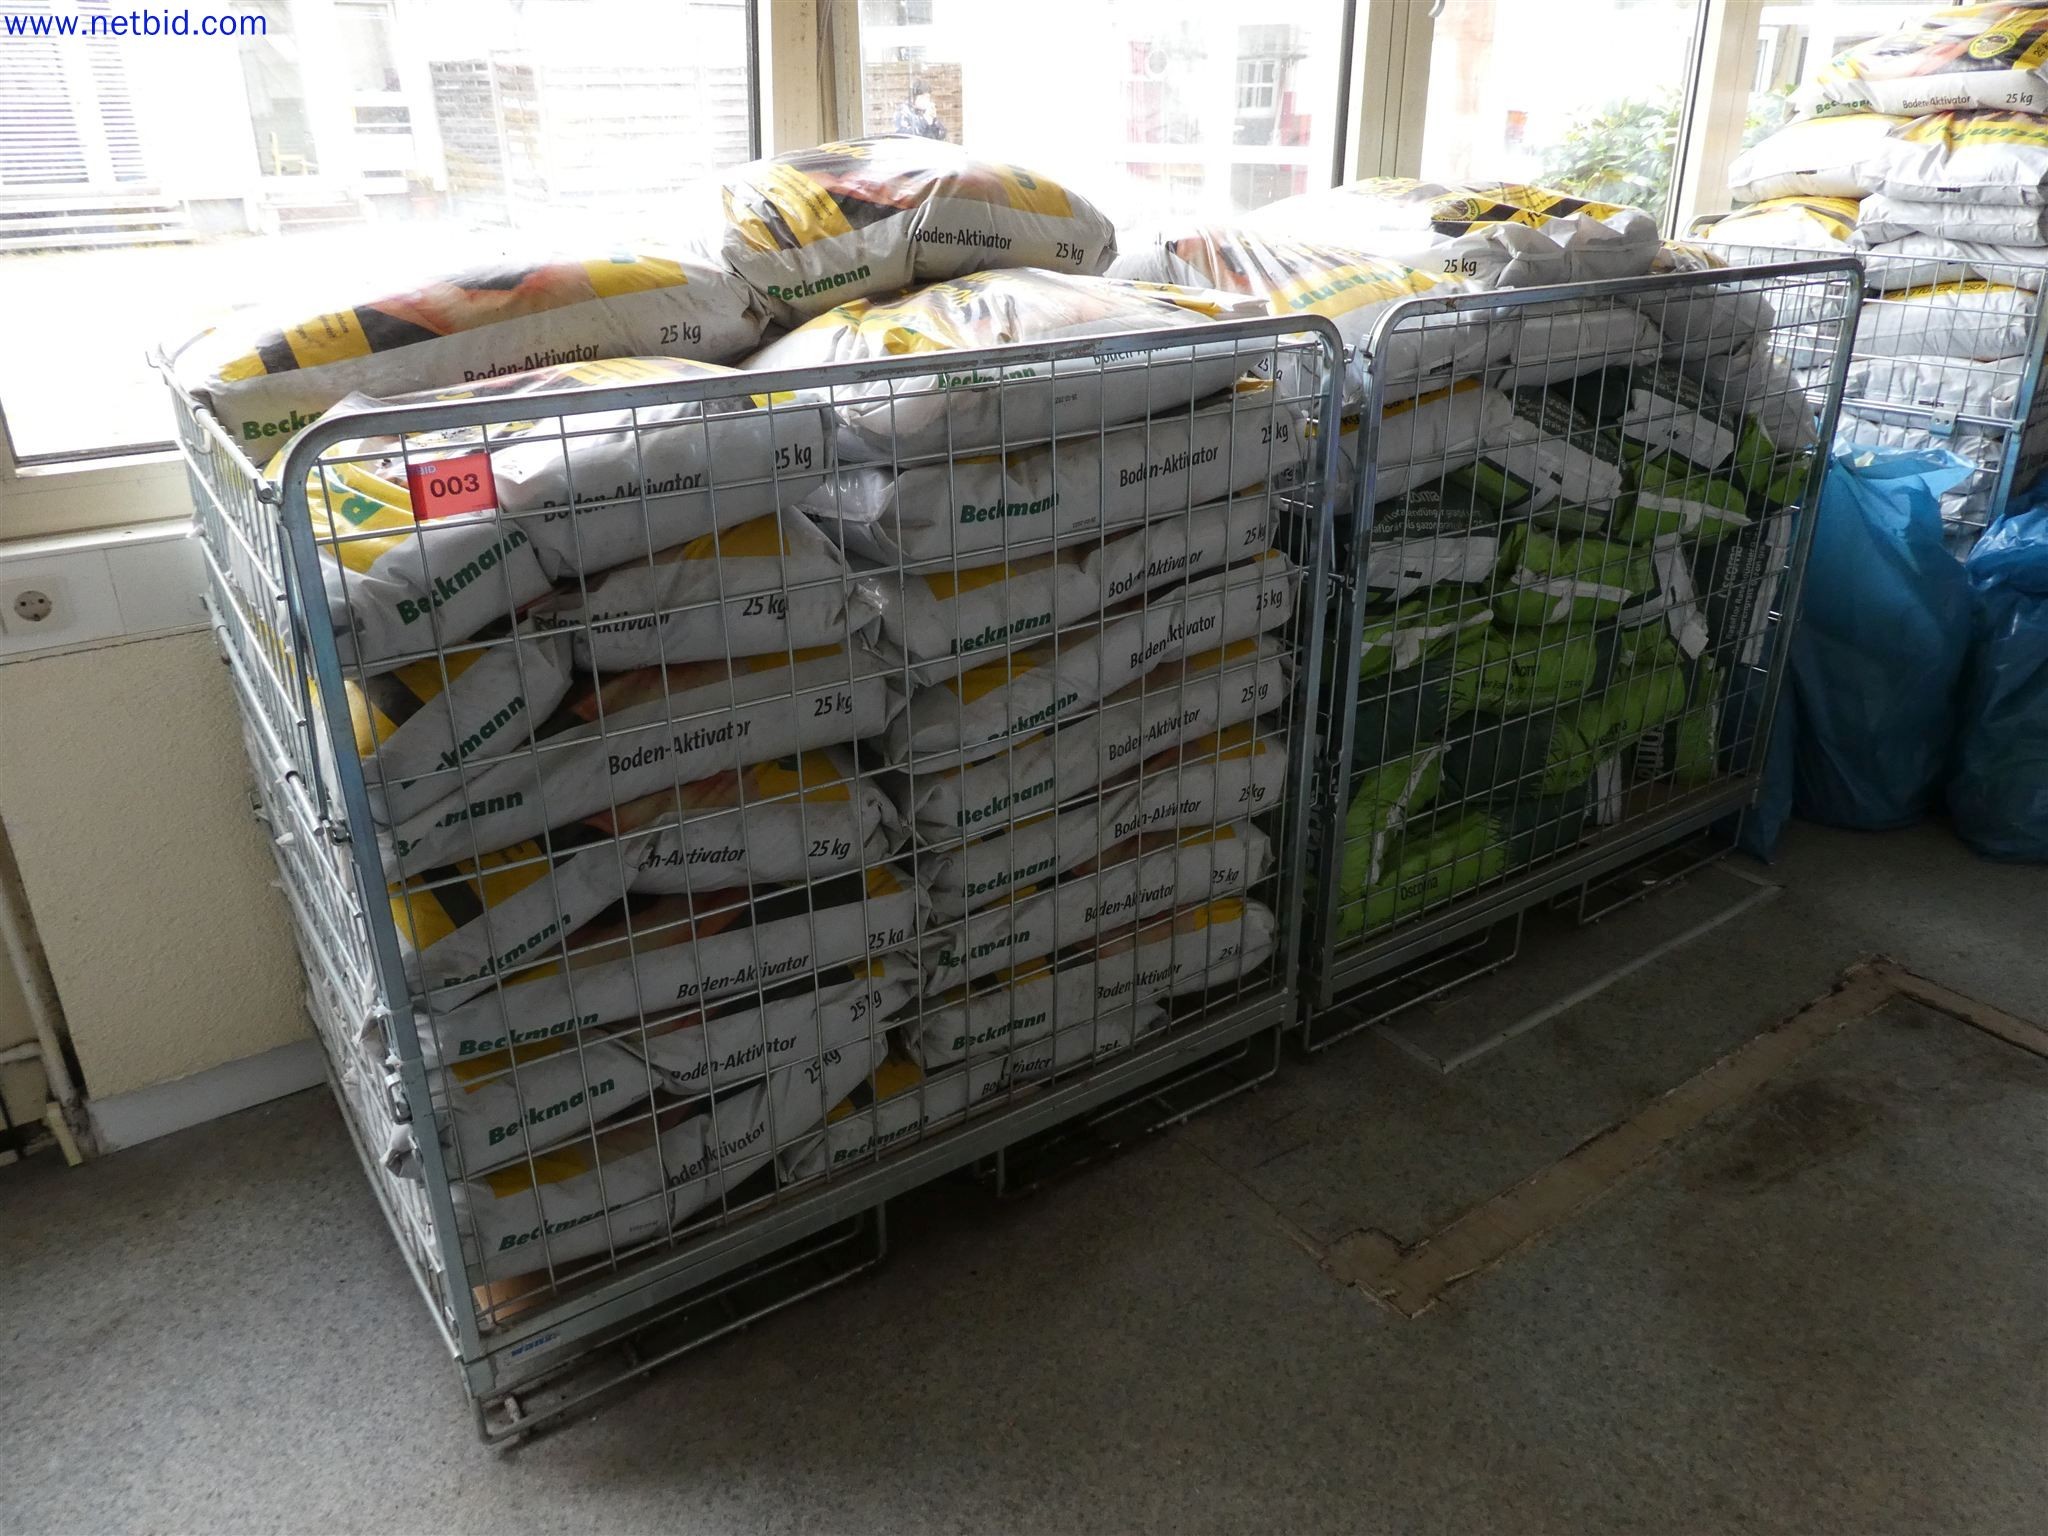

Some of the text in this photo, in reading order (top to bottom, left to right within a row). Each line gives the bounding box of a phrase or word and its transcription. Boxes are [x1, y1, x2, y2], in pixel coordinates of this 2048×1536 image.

[2006, 93, 2018, 104] 25
[2020, 92, 2034, 105] kg
[1056, 242, 1071, 259] 25
[1071, 242, 1085, 265] kg
[1443, 258, 1477, 277] 25 kg
[767, 262, 871, 301] Beckmann
[660, 325, 679, 344] 25
[683, 322, 701, 344] kg
[794, 444, 812, 469] kg
[1119, 446, 1219, 487] Boden-Aktivator
[1275, 421, 1289, 444] kg
[430, 473, 480, 498] 003
[960, 493, 1060, 524] Beckmann
[1244, 529, 1256, 546] 25
[396, 528, 528, 625] Beckmann
[742, 597, 763, 617] 25
[768, 594, 789, 620] kg
[1270, 589, 1283, 609] kg
[1241, 686, 1254, 704] 25
[607, 691, 853, 776] Boden-Aktivator 25 kg
[808, 839, 829, 857] 25
[832, 837, 851, 860] kg
[868, 933, 886, 950] 25
[850, 1001, 866, 1022] 25
[458, 1012, 599, 1056] Beckmann
[488, 1077, 615, 1146] Beckmann
